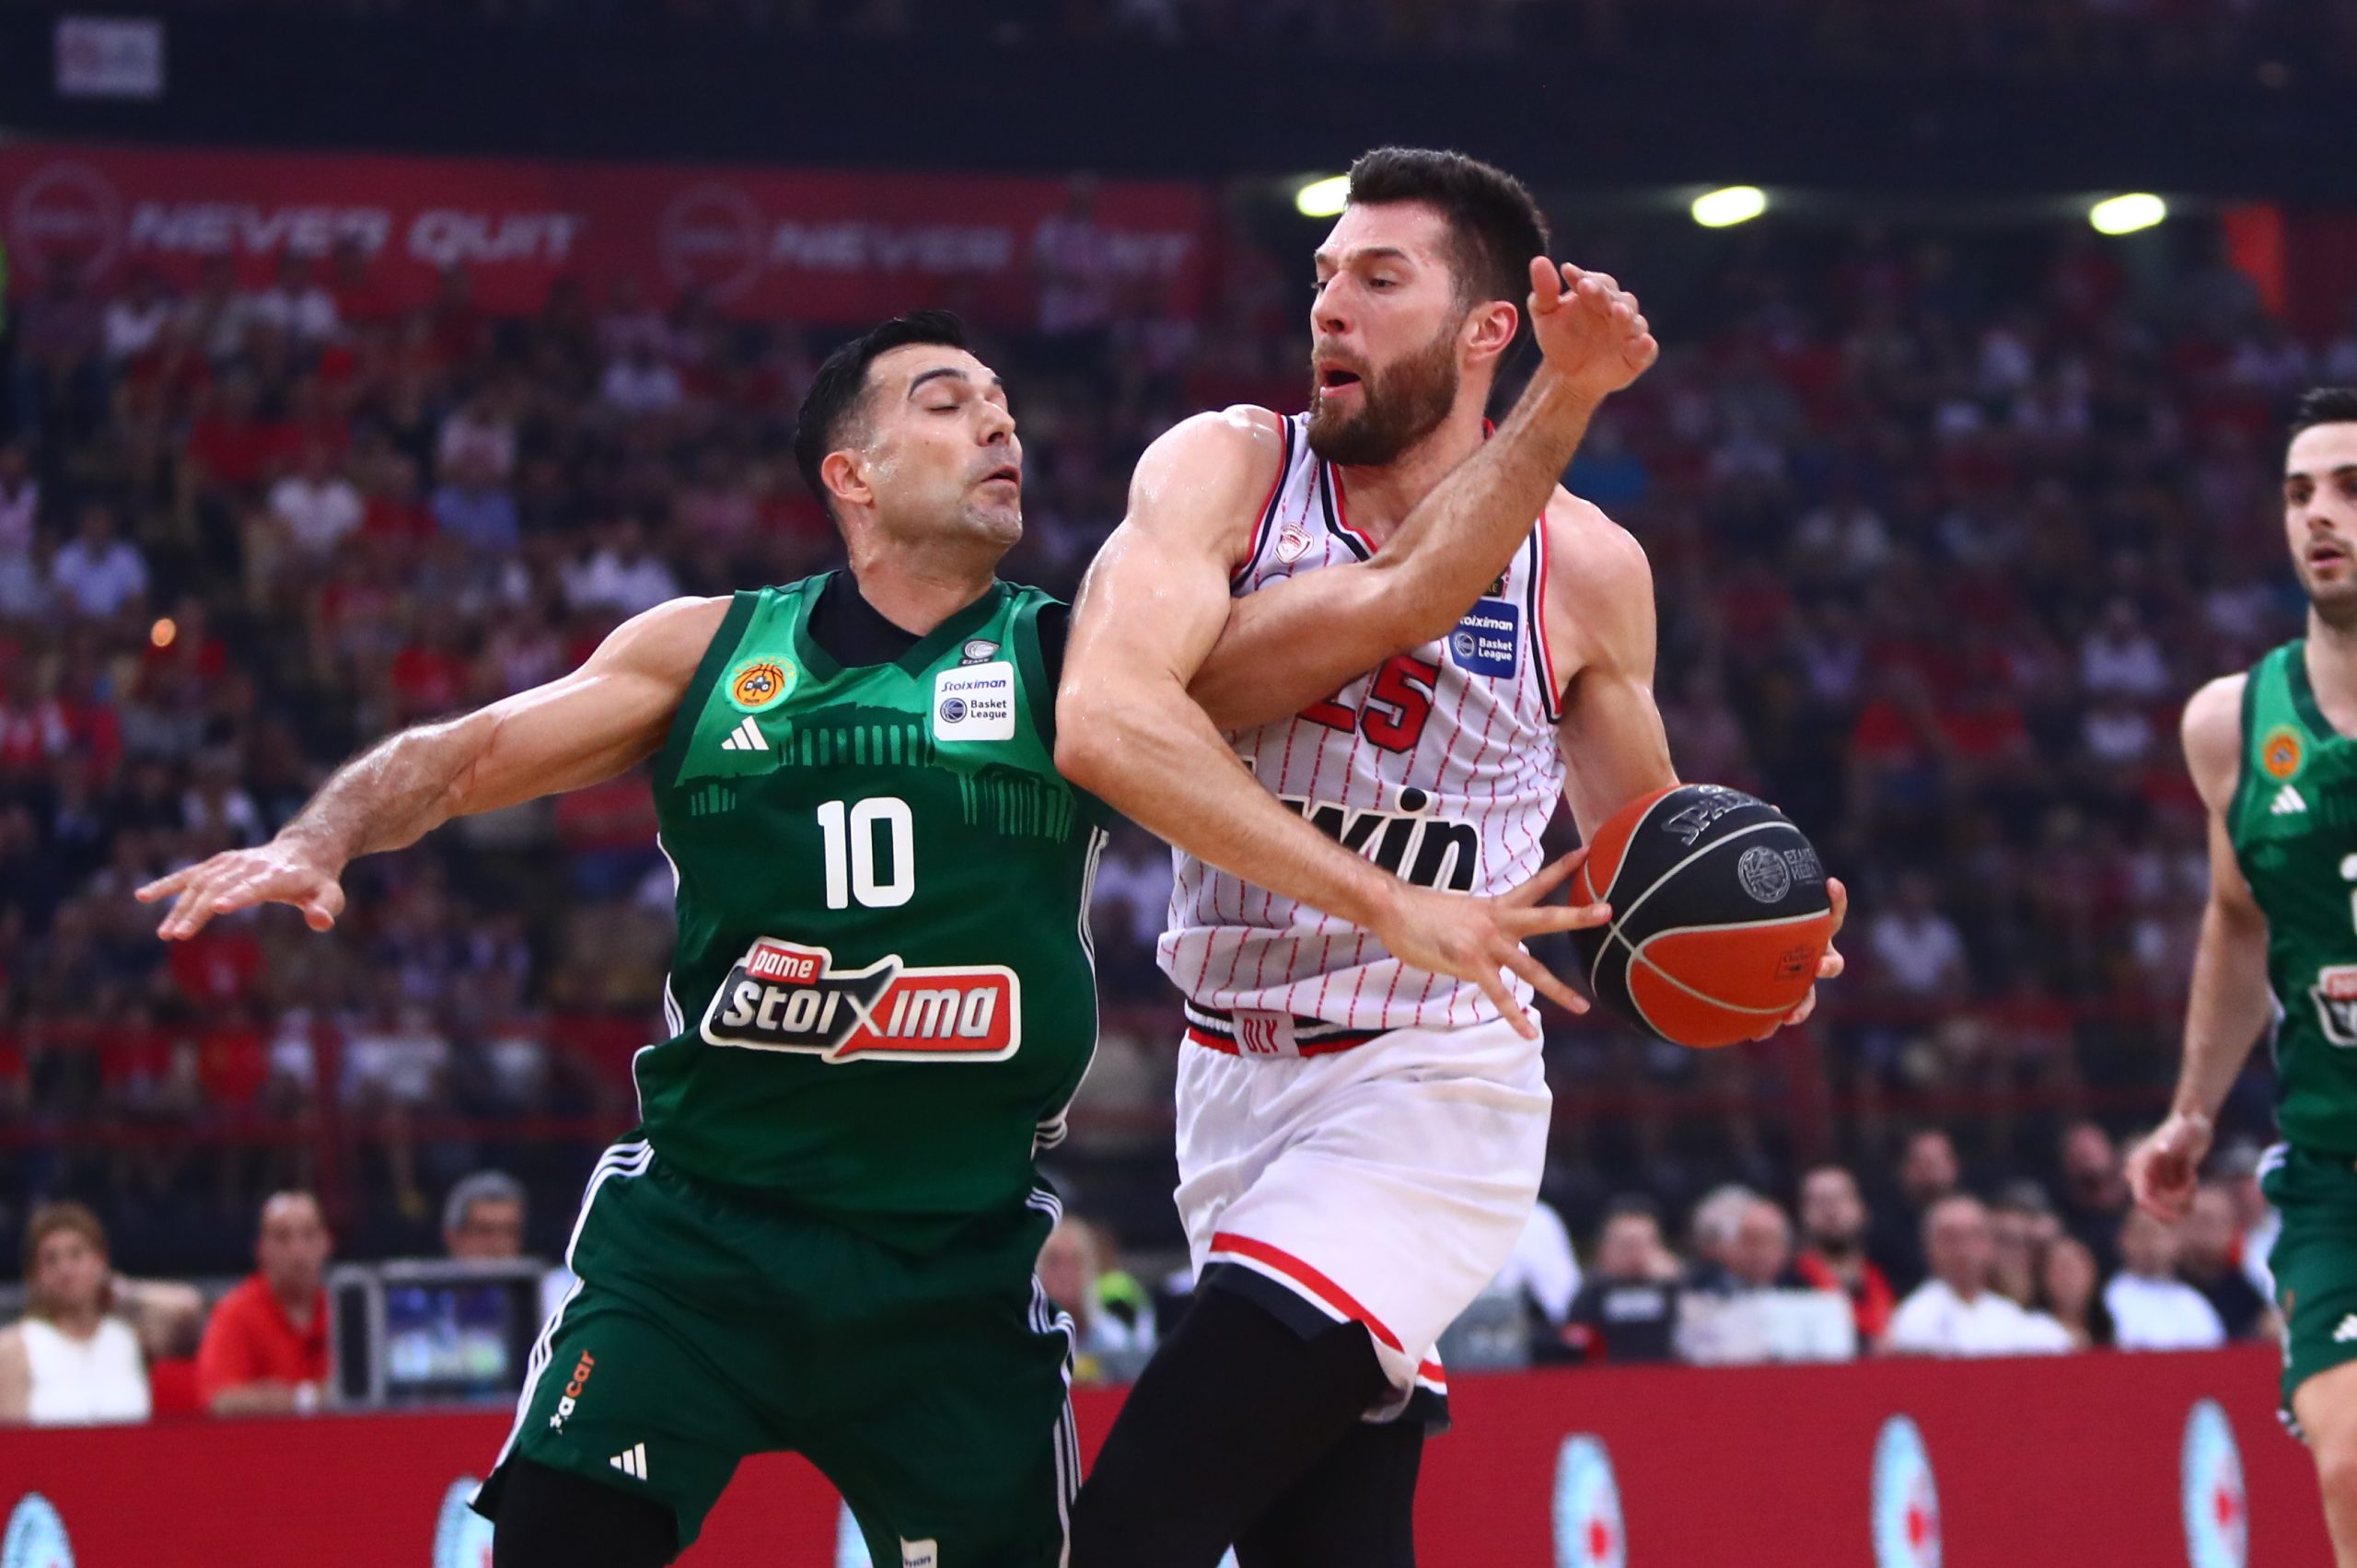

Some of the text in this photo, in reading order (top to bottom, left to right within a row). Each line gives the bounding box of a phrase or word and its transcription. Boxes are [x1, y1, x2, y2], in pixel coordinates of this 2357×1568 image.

[129, 202, 584, 263] NEVER QUIT
[1459, 615, 1514, 633] oiximan
[1479, 636, 1513, 651] Basket
[1478, 647, 1513, 662] League
[941, 679, 1007, 693] Stoiximan
[970, 699, 1007, 709] Basket
[970, 709, 1007, 721] League
[1243, 757, 1479, 892] win
[817, 796, 916, 910] 10
[751, 948, 814, 981] pame
[1242, 1016, 1279, 1053] OLY
